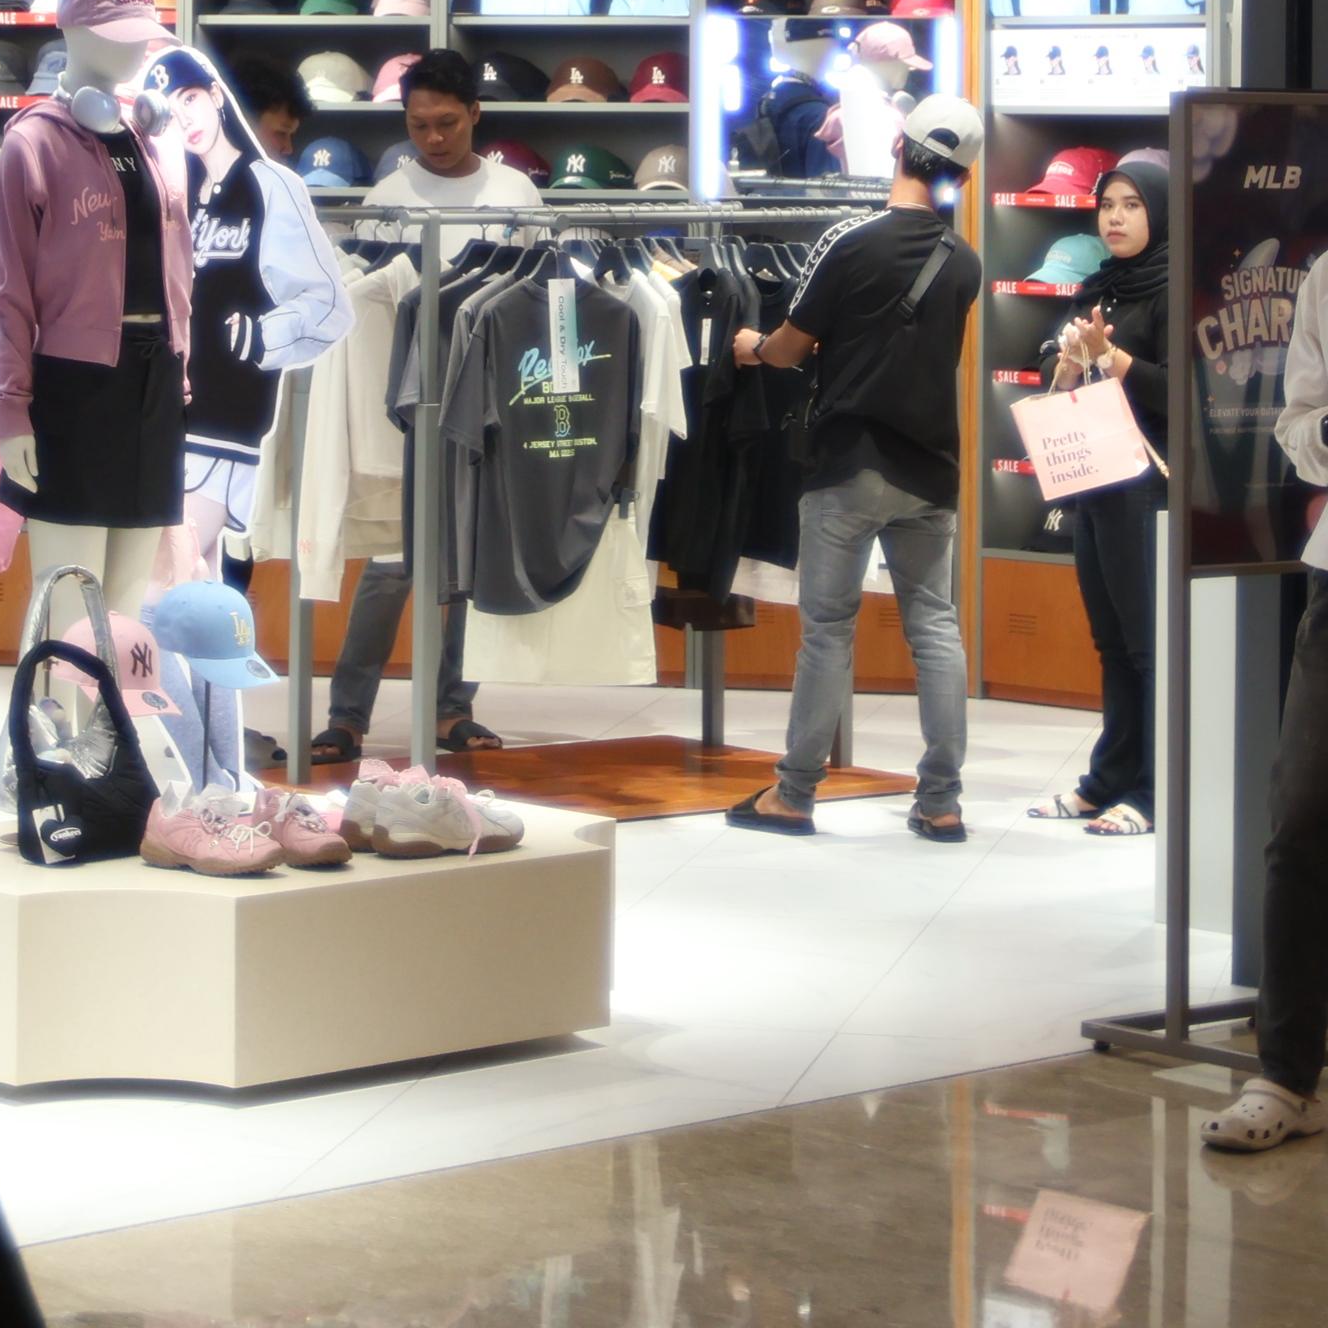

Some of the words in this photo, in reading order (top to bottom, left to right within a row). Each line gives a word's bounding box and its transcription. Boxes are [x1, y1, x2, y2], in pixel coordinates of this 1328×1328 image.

[312, 147, 331, 167] NY
[566, 153, 587, 173] NY
[657, 154, 676, 174] NY
[1243, 164, 1302, 190] MLB
[994, 193, 1017, 206] SALE
[1054, 195, 1077, 208] SALE
[996, 281, 1017, 294] SALE
[1197, 297, 1295, 361] CHAR
[997, 370, 1019, 383] SALE
[553, 404, 571, 438] B
[1041, 430, 1087, 452] Pretty
[997, 459, 1019, 473] SALE
[1045, 446, 1093, 469] things
[1049, 462, 1100, 485] inside.
[1043, 507, 1064, 532] NY
[229, 610, 252, 648] LA
[130, 641, 154, 678] NY
